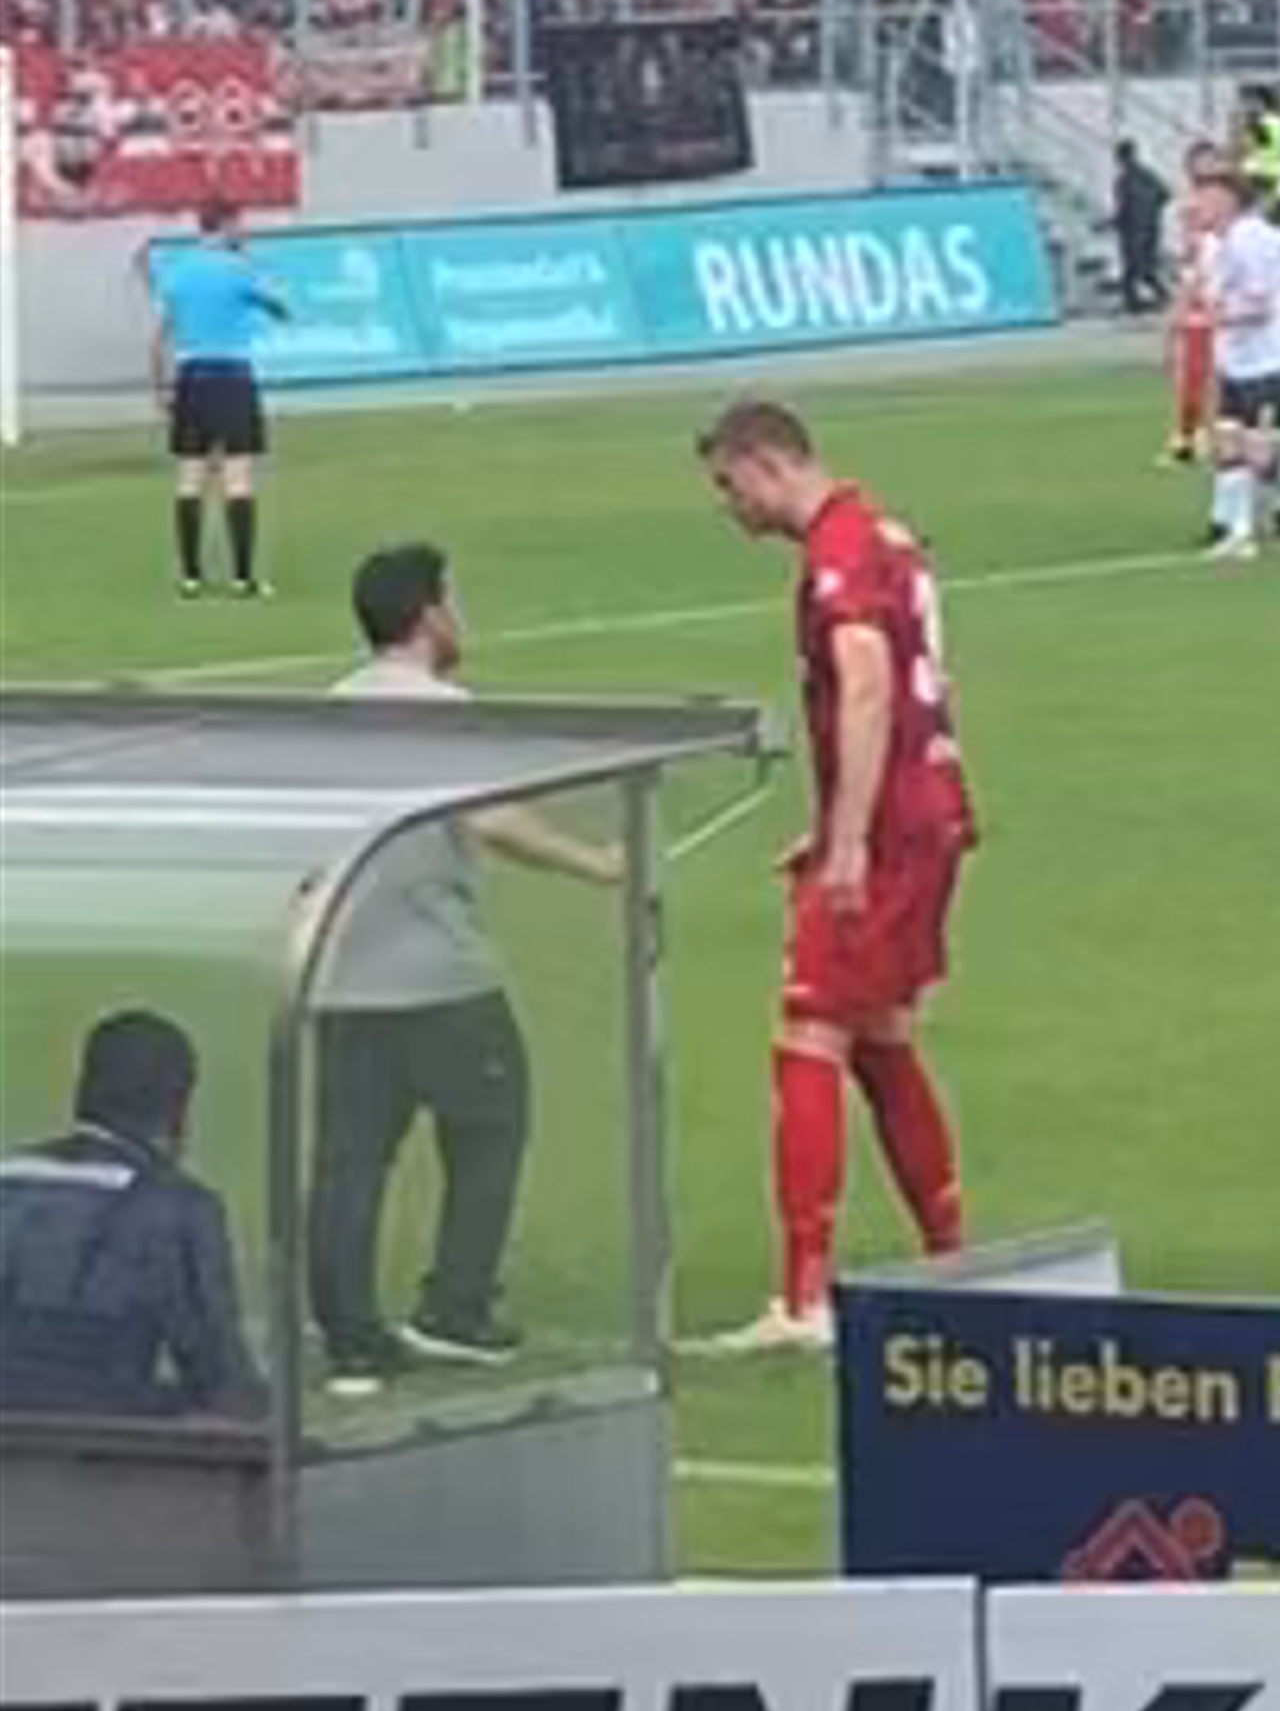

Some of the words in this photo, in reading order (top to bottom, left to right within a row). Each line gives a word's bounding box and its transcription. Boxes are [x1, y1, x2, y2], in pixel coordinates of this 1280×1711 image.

[694, 224, 990, 335] RUNDAS
[884, 1334, 988, 1407] Sie
[1014, 1338, 1238, 1421] lieben
